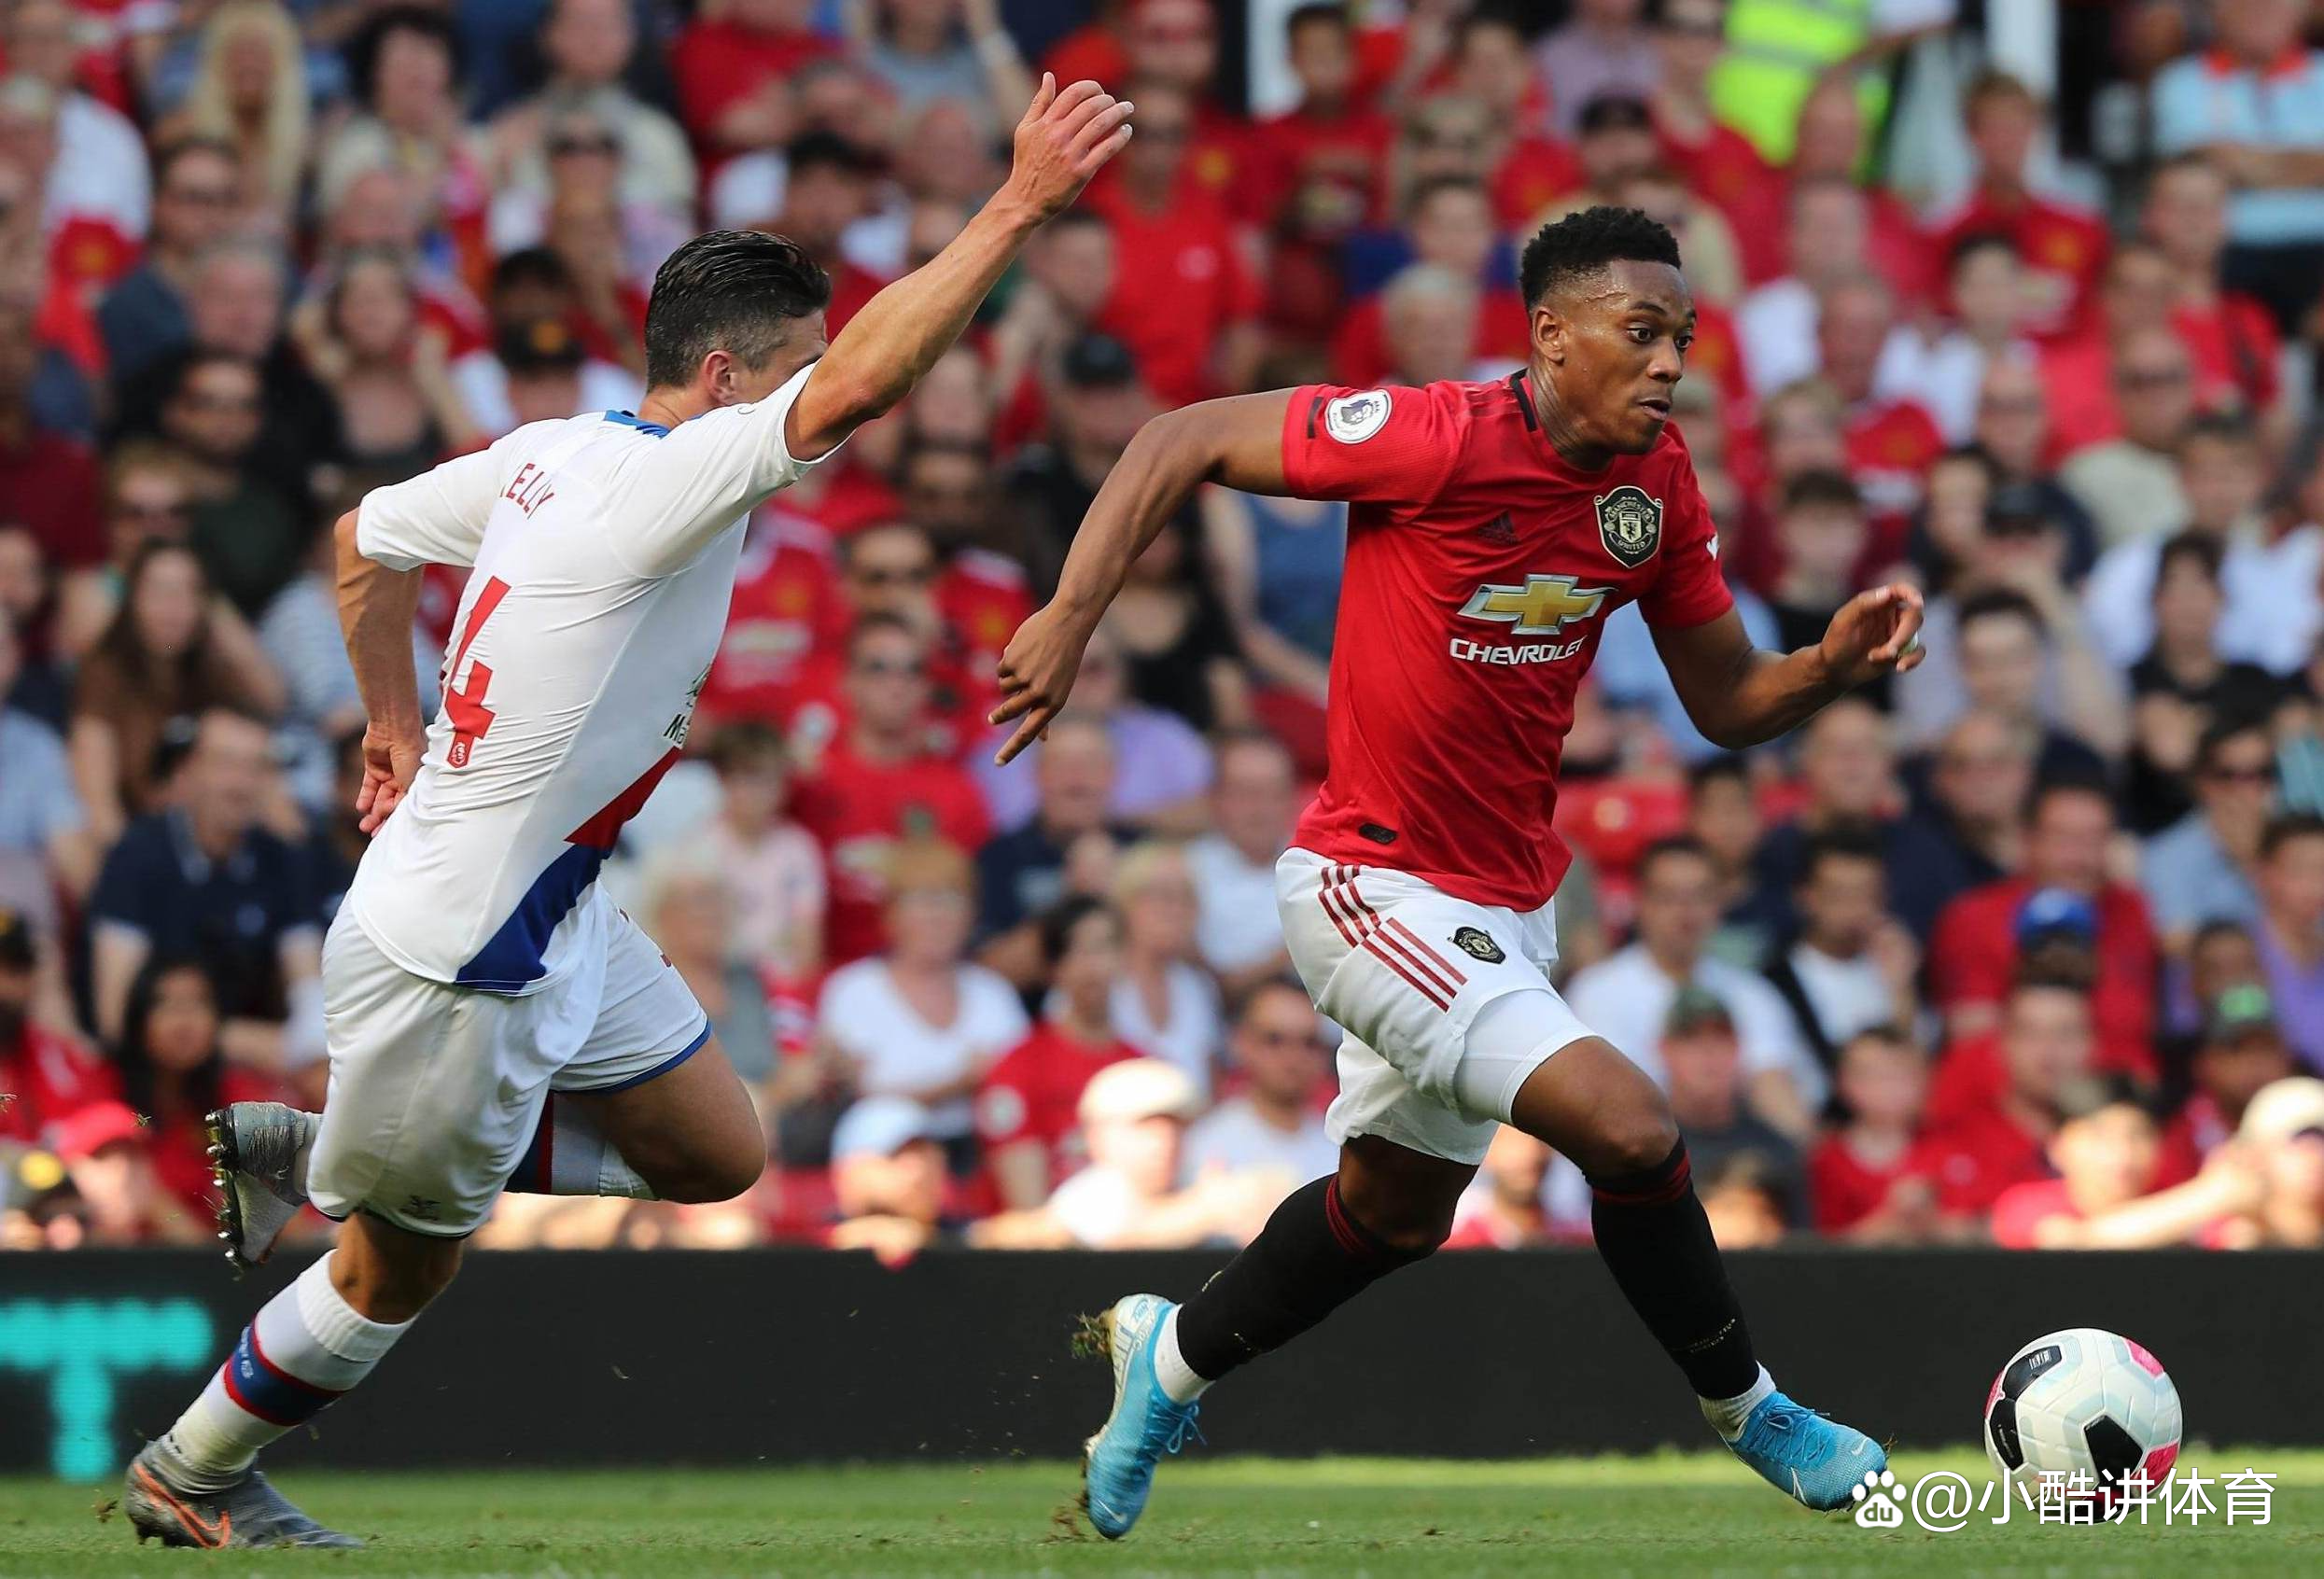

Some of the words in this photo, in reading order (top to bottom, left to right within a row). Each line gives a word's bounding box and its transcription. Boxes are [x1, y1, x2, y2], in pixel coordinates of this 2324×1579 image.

[499, 463, 555, 519] ELLY
[444, 575, 512, 769] 4
[1449, 636, 1588, 665] CHEVROLET
